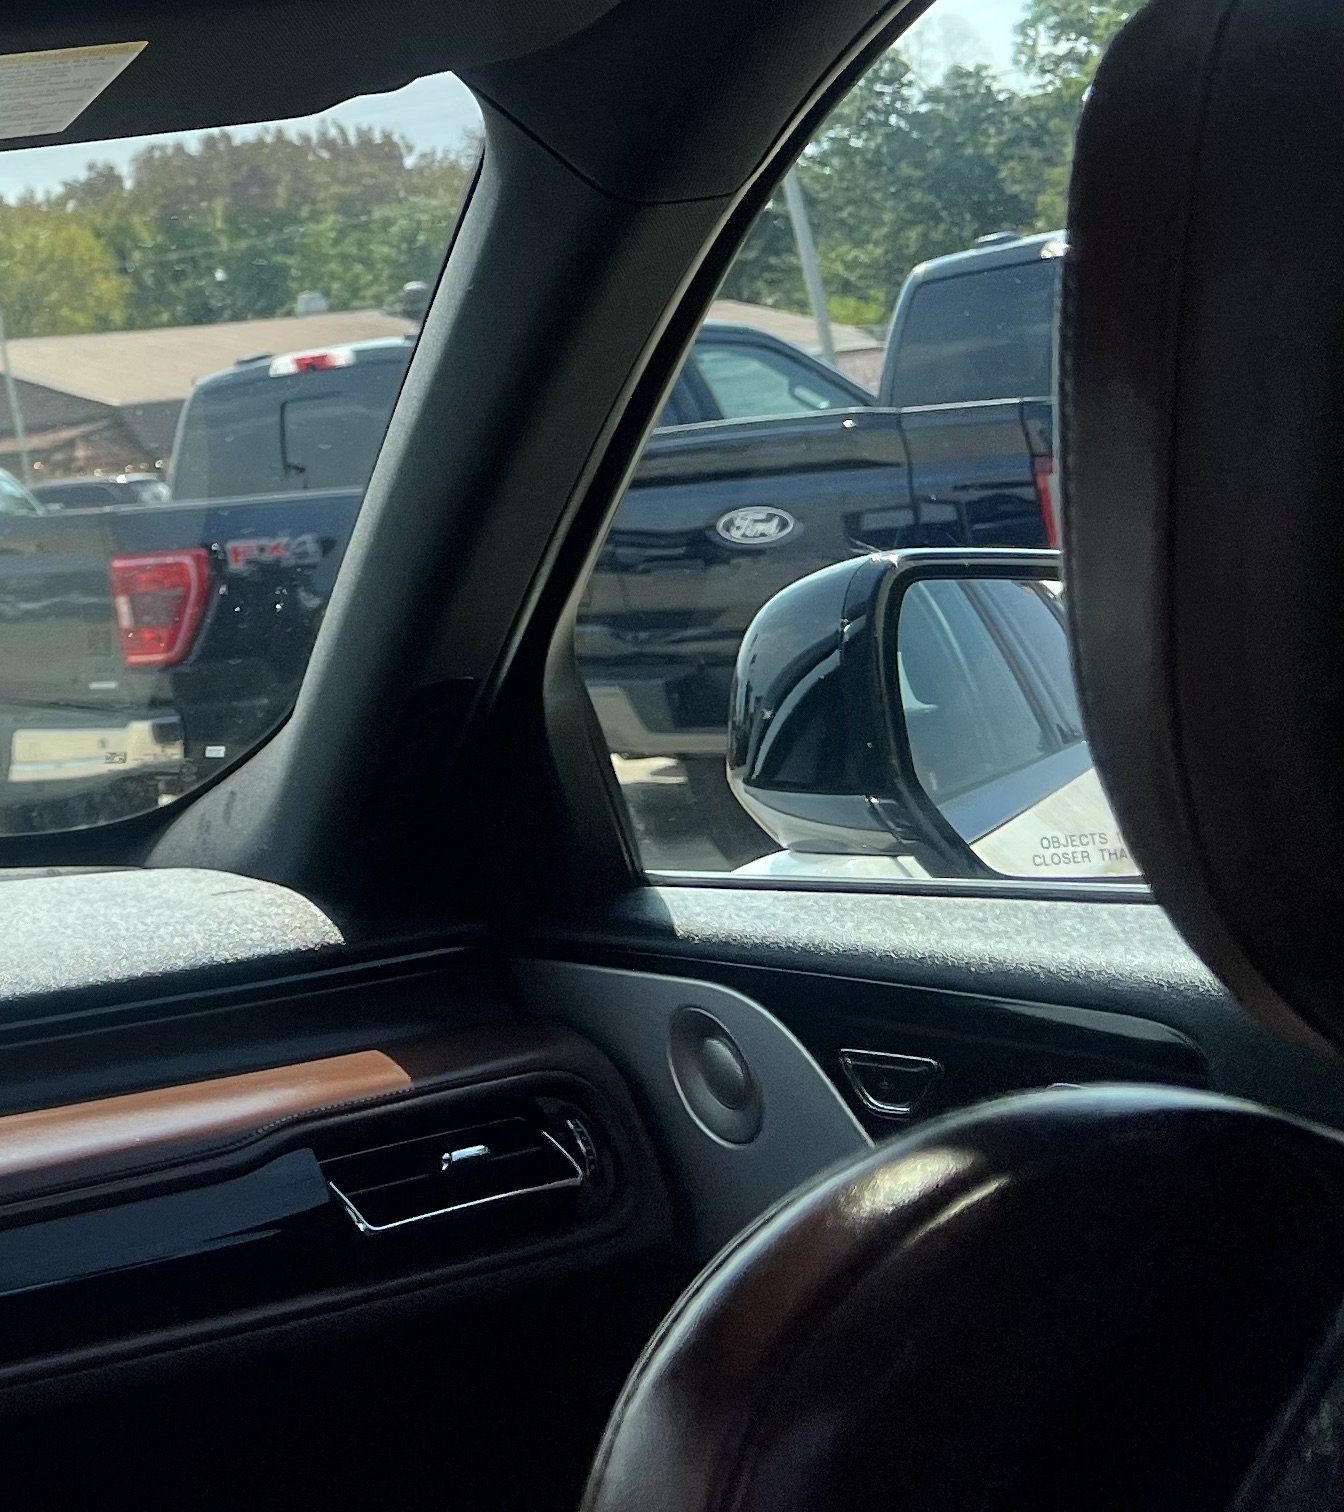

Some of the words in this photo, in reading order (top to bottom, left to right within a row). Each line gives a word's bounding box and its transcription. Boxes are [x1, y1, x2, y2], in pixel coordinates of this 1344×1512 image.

[730, 512, 780, 538] Ford
[1040, 832, 1108, 849] OBJECTS
[1032, 850, 1091, 866] CLOSER
[1098, 848, 1129, 862] THA
